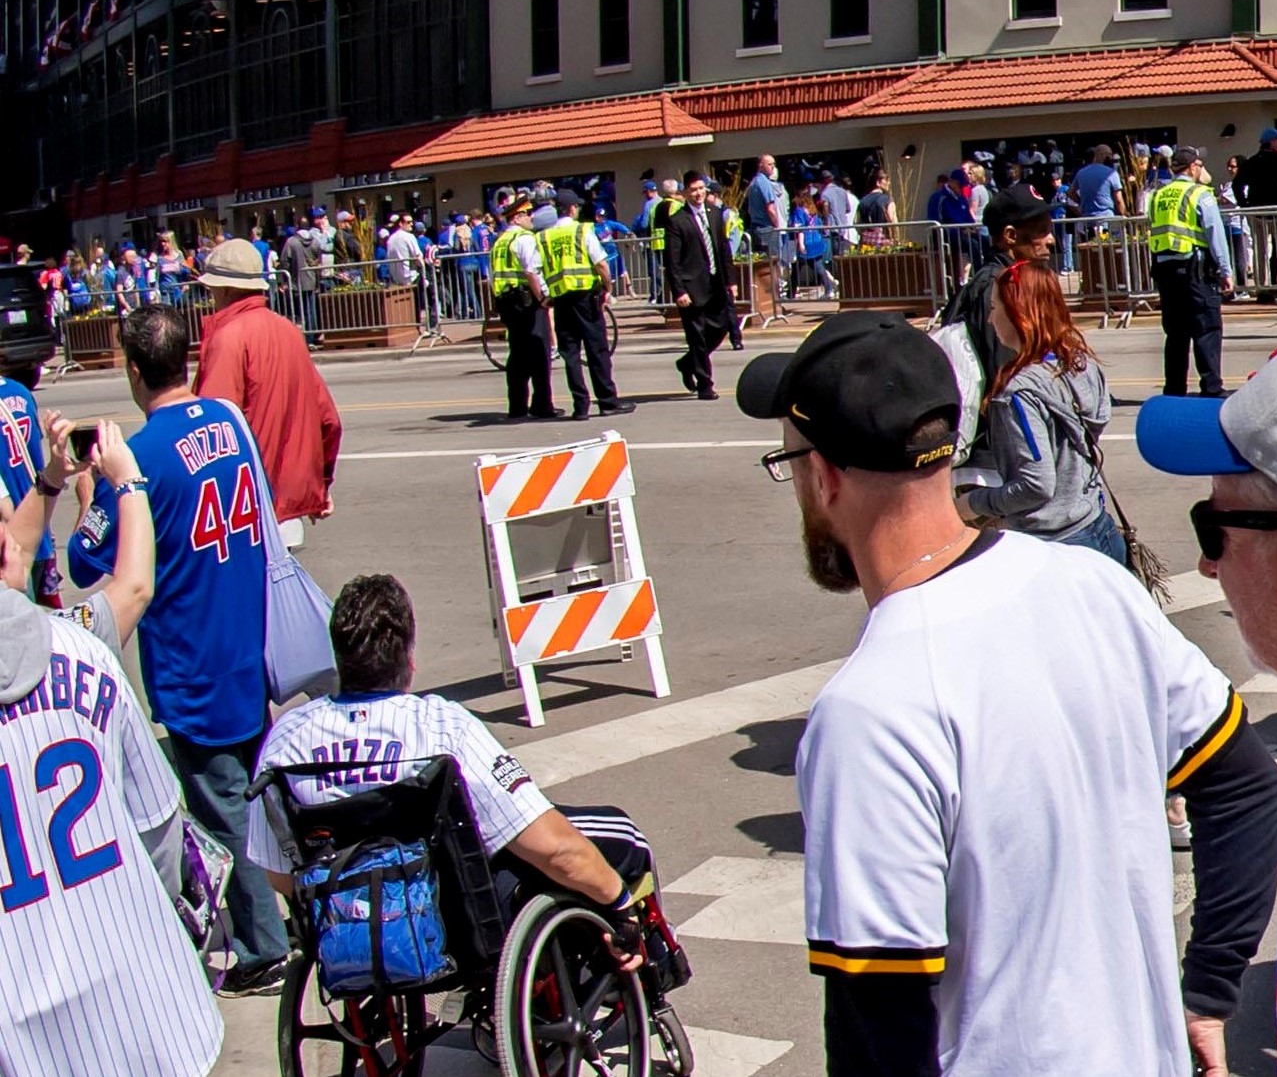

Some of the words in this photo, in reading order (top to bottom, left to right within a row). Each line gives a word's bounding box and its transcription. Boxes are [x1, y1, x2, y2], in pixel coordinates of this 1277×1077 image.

[176, 422, 240, 475] RIZZO
[915, 444, 955, 468] PIRATES
[190, 462, 261, 563] 44
[311, 738, 404, 792] RIZZO
[492, 758, 521, 780] WORLD
[0, 738, 124, 913] 12
